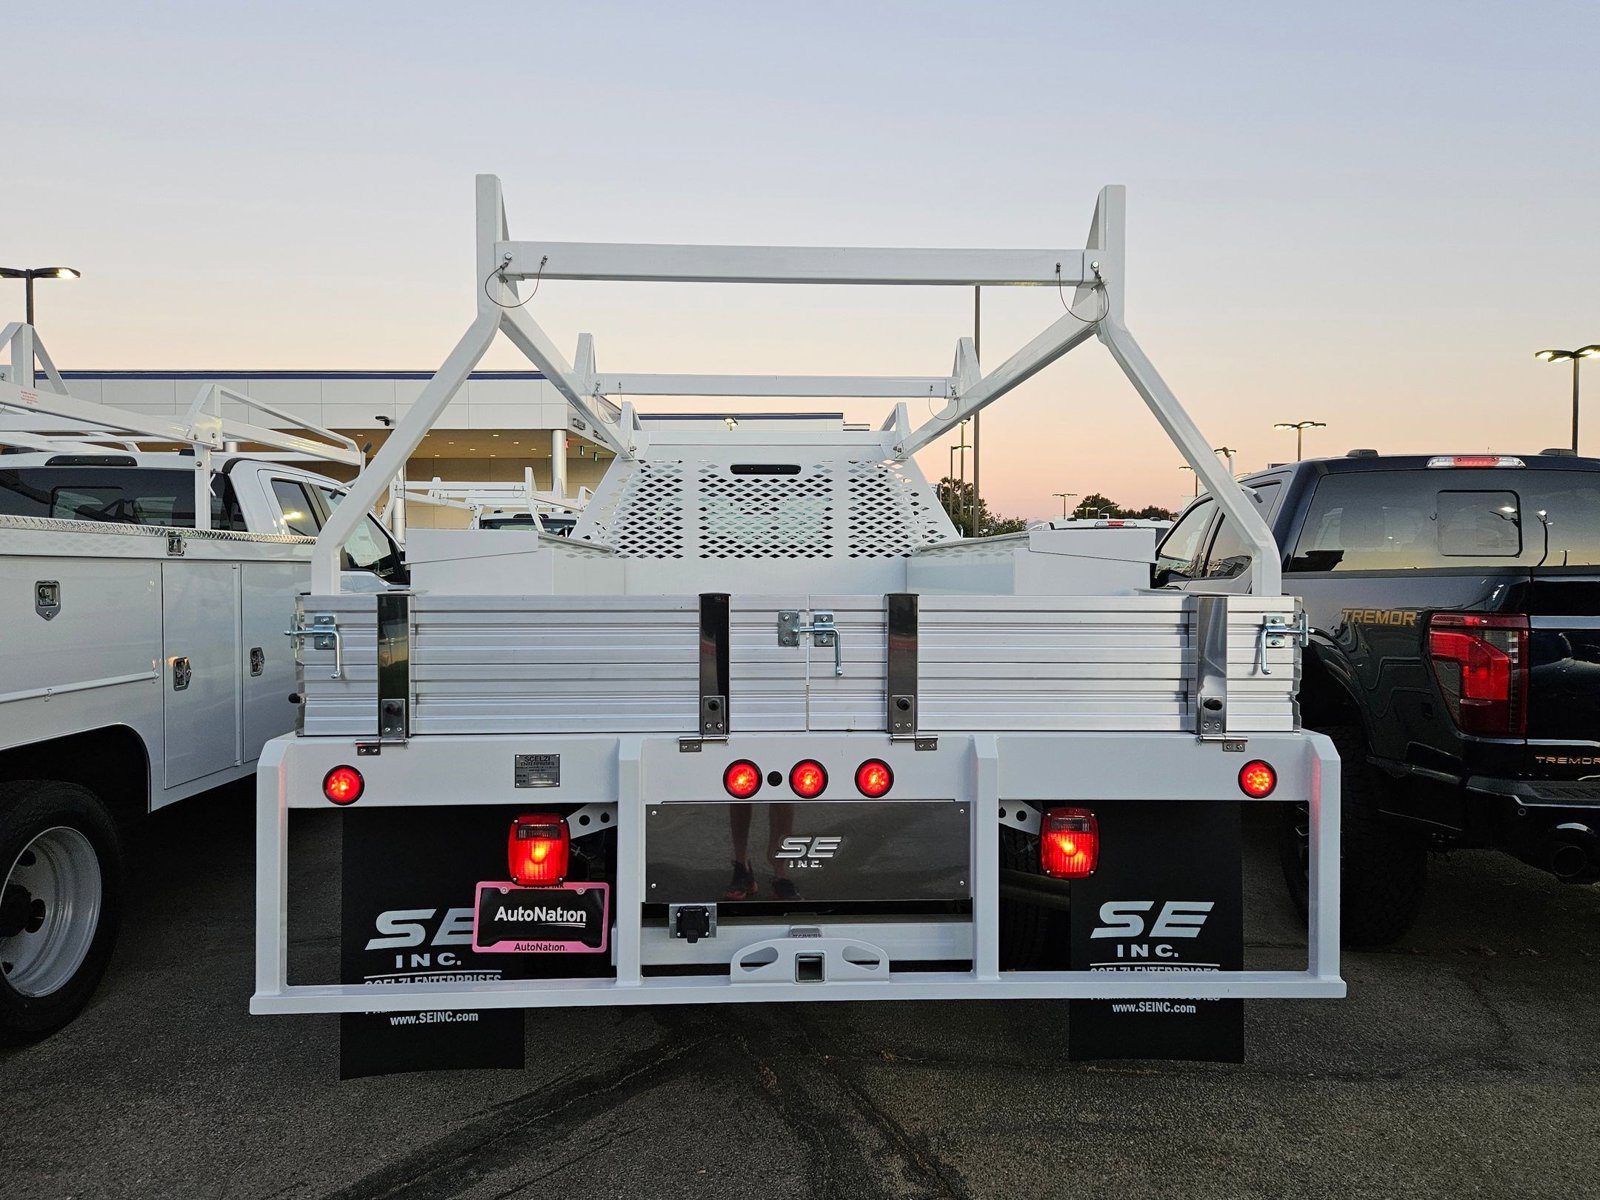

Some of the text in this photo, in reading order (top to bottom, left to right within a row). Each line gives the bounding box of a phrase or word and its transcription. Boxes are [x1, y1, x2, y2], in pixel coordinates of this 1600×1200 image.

[1341, 608, 1417, 626] TREMOR
[1535, 756, 1600, 765] TREMOR
[775, 836, 842, 858] SE
[788, 860, 823, 868] INC.
[494, 905, 587, 922] AutoNation
[1090, 900, 1215, 939] SE
[1116, 944, 1179, 958] INC.
[395, 952, 462, 969] INC.
[1111, 1001, 1197, 1014] www.SEINC.com
[389, 1010, 479, 1026] www.SEINC.com
